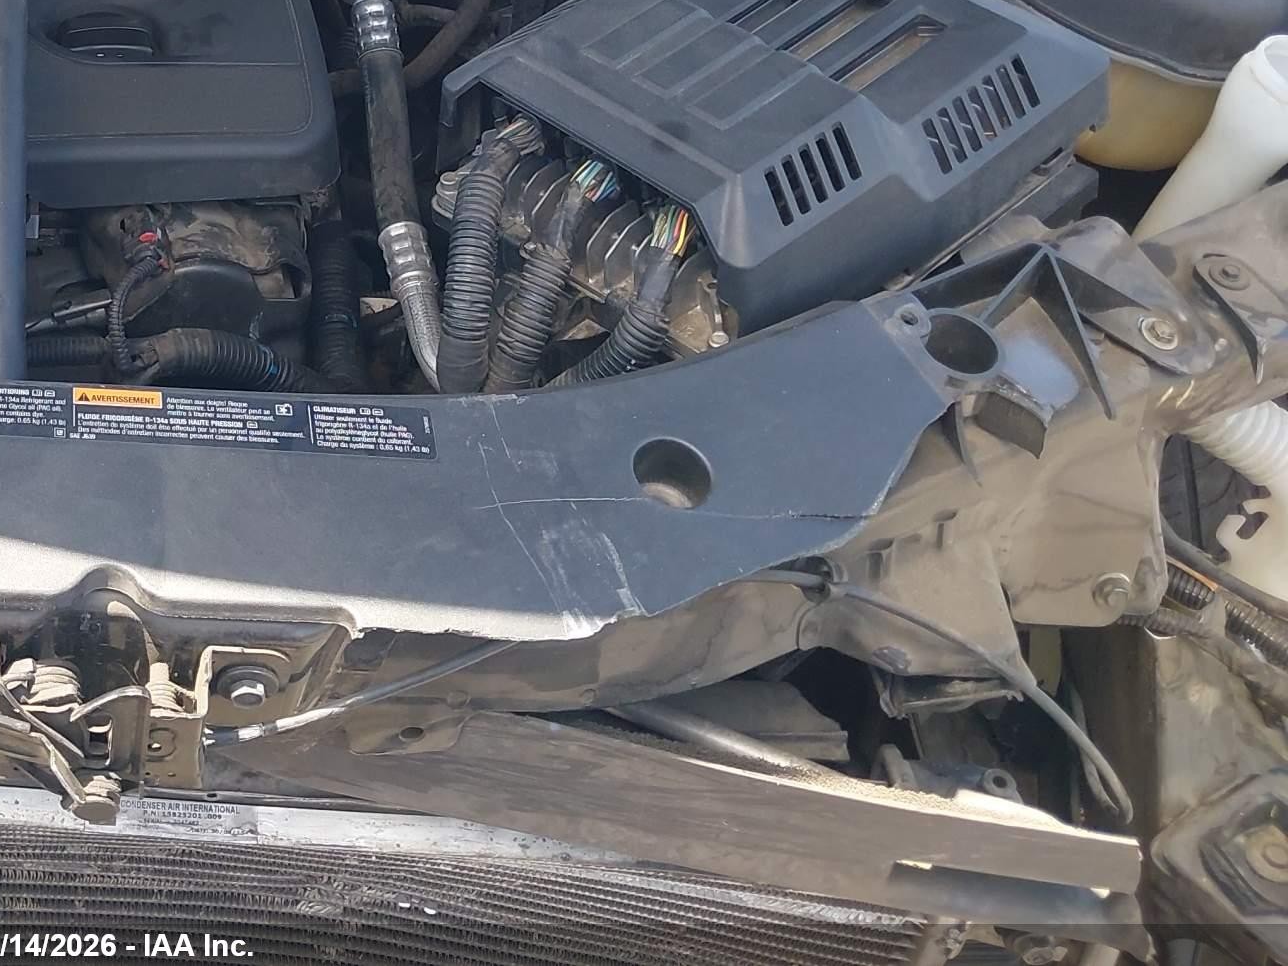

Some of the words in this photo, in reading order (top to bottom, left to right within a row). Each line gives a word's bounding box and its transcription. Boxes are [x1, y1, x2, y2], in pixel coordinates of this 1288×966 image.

[92, 394, 155, 405] AVERTISSEMENT
[120, 799, 167, 811] CONDENSER
[168, 802, 181, 811] AIR
[182, 803, 240, 814] INTERNATIONAL
